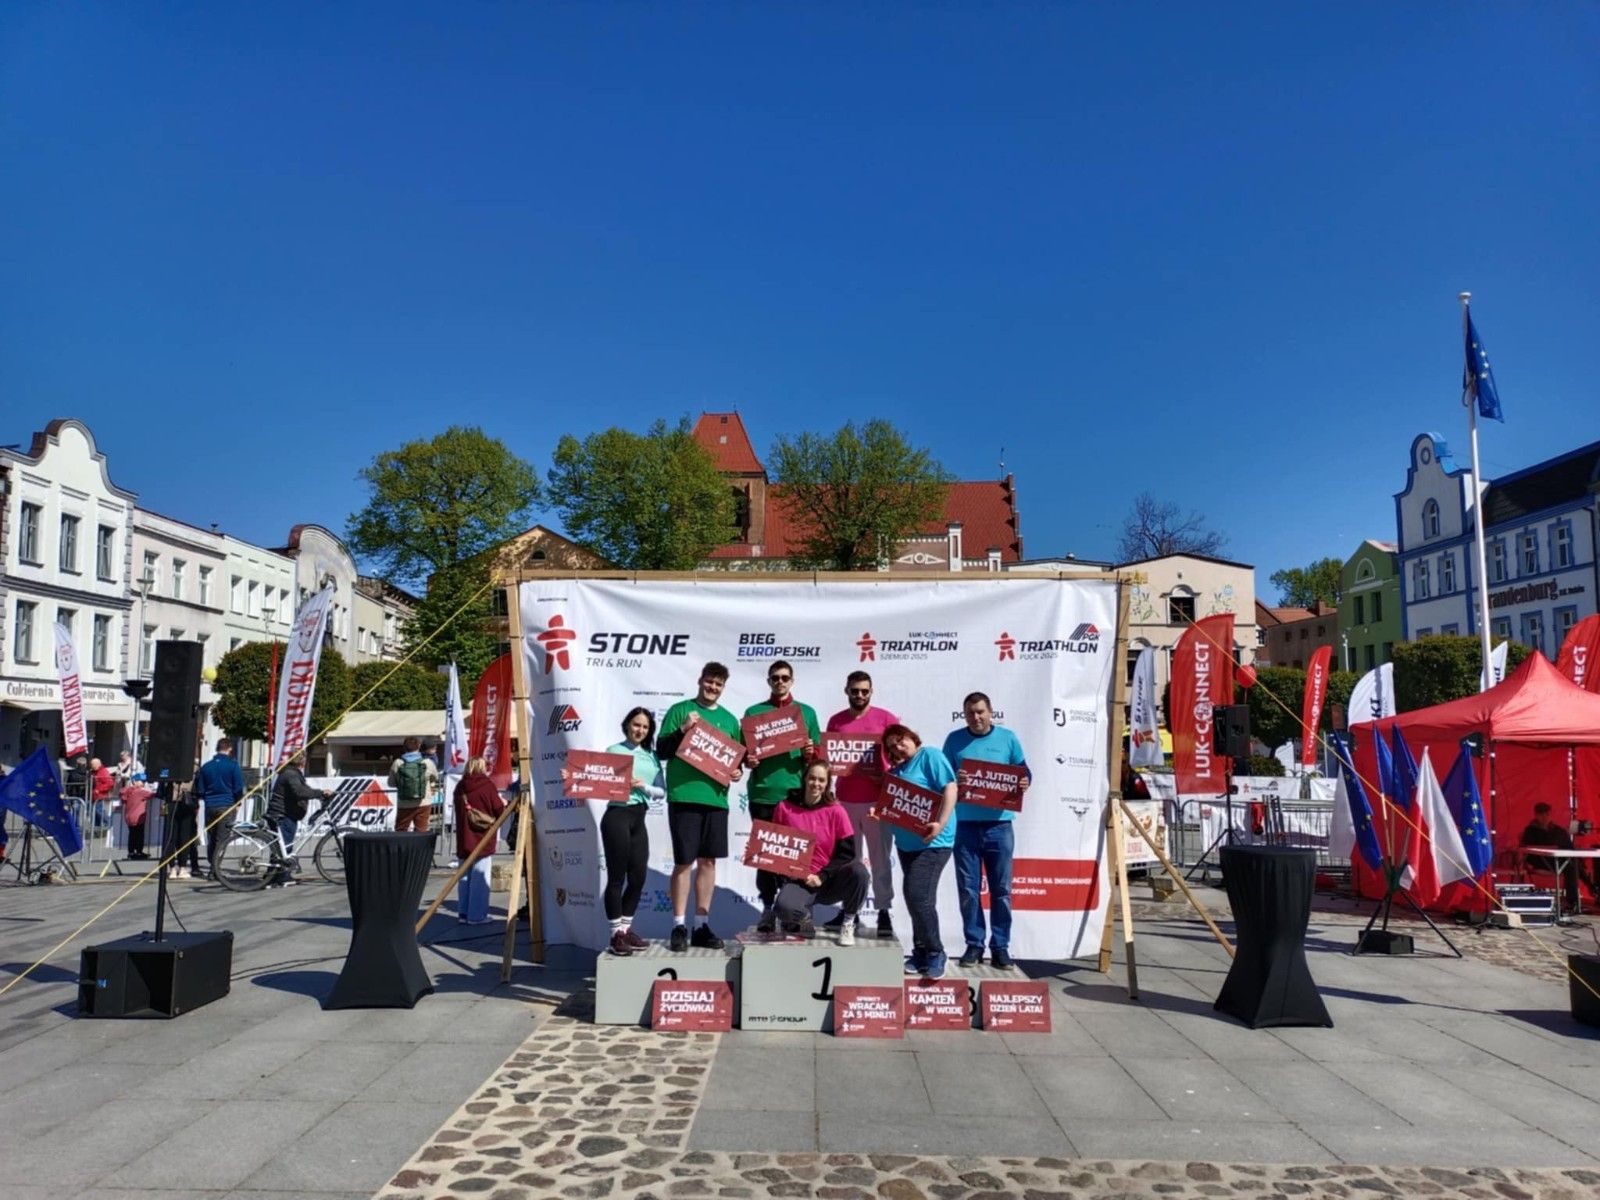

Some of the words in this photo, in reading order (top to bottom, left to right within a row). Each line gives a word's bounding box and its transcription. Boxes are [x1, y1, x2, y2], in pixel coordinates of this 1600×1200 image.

[1488, 578, 1559, 610] randenburg
[588, 632, 689, 656] STONE
[738, 633, 775, 645] BIEG
[737, 646, 821, 657] EUROPEJSKI
[880, 640, 958, 652] TRIATHLON
[1019, 641, 1098, 653] TRIATHLON
[586, 657, 605, 667] TRI
[606, 658, 613, 668] &
[616, 658, 642, 668] RUN
[7, 682, 54, 697] Cukiernia
[62, 673, 84, 744] CZANIECKI
[279, 660, 314, 765] ANIECKI
[556, 719, 582, 733] PGK
[690, 734, 734, 768] SKAŁA!
[827, 739, 875, 752] DAJCIE
[827, 751, 874, 763] WODY!
[584, 764, 614, 775] MEGA
[985, 770, 1018, 783] JUTRO
[966, 778, 1017, 793] ZAKWASY!
[887, 783, 933, 811] DAŁAM
[348, 807, 394, 826] PGK
[892, 798, 932, 824] RADĘ!
[757, 829, 790, 846] MAM
[792, 837, 810, 853] TĘ
[1011, 887, 1047, 895] onetrirun
[811, 956, 833, 1001] 1
[661, 990, 715, 1002] DZISIAJ
[909, 993, 956, 1005] KAMIEŃ
[989, 994, 1043, 1004] NAJLEPSZY
[659, 1002, 714, 1013] ŻYCIÓWKA!
[848, 1002, 889, 1010] WRACAM
[925, 1006, 935, 1014] W
[936, 1006, 963, 1016] WODĘ
[1019, 1005, 1044, 1013] LATA!
[842, 1010, 855, 1018] ZA
